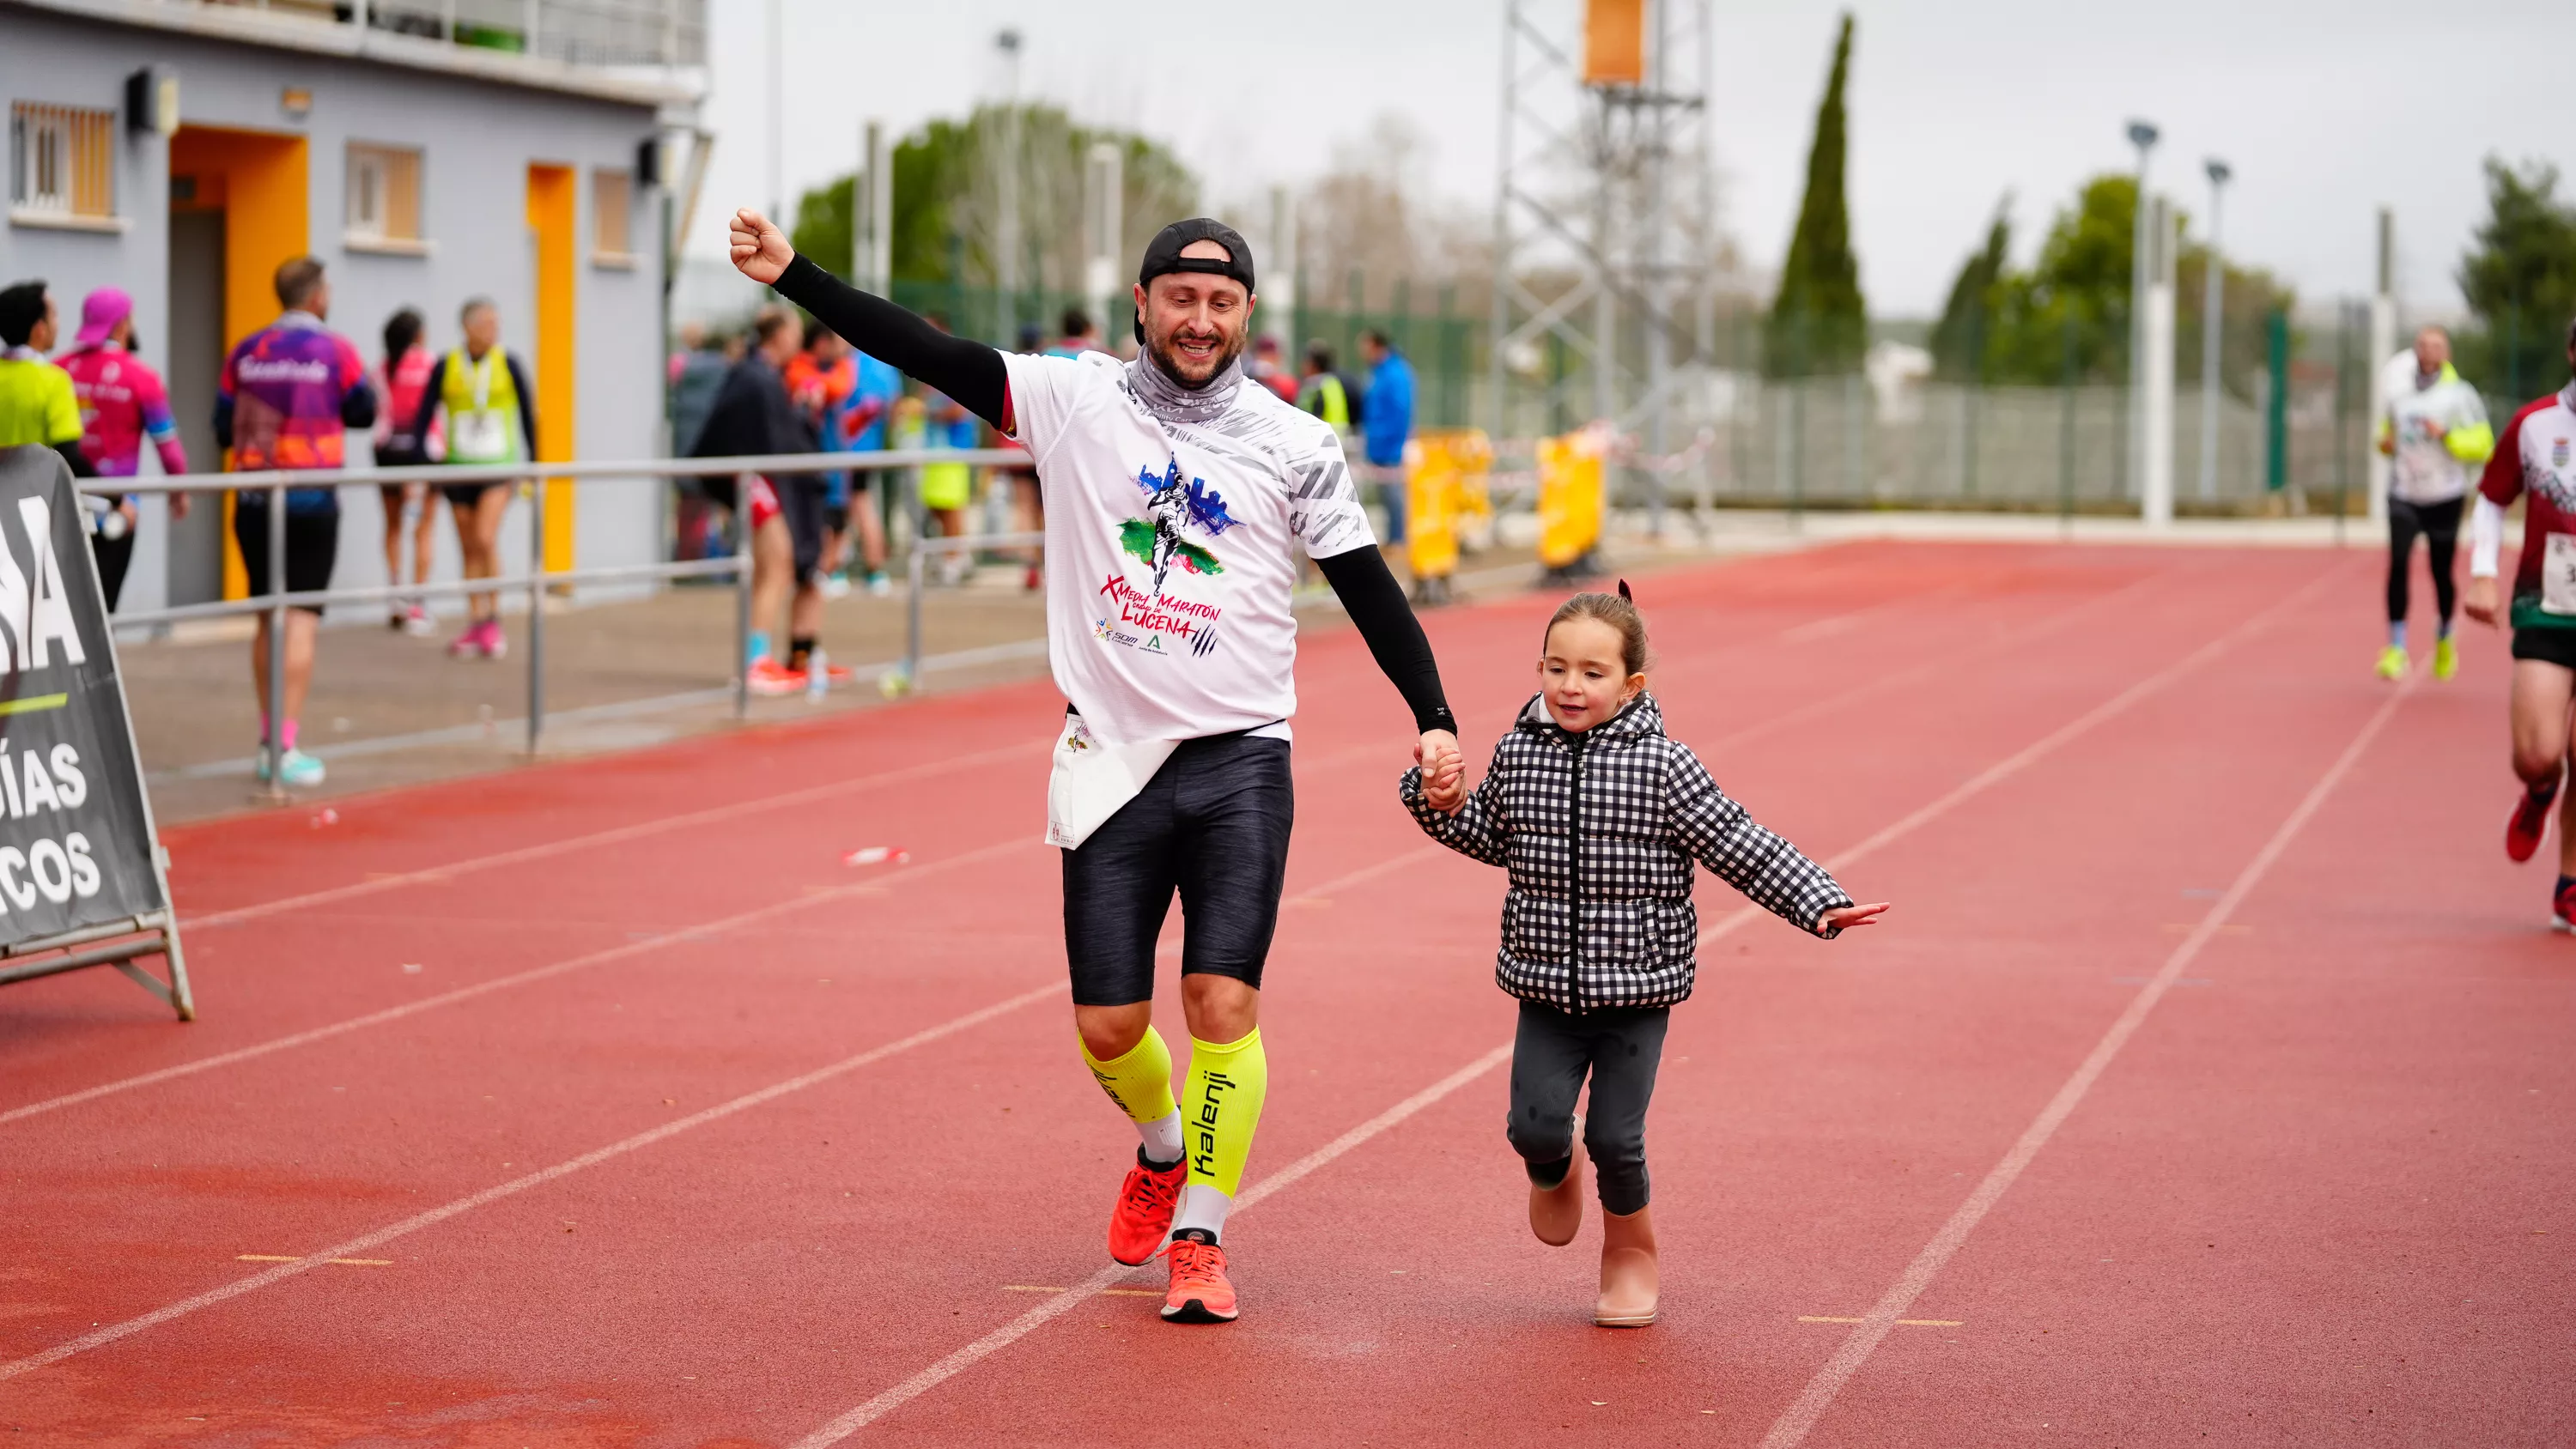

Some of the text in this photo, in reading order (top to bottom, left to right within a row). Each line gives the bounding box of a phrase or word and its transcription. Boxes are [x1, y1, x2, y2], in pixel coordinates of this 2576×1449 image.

[1121, 602, 1197, 639] LUCENA
[1157, 593, 1221, 621] MARATÓN
[0, 737, 87, 820] ÍAS
[0, 832, 101, 916] COS
